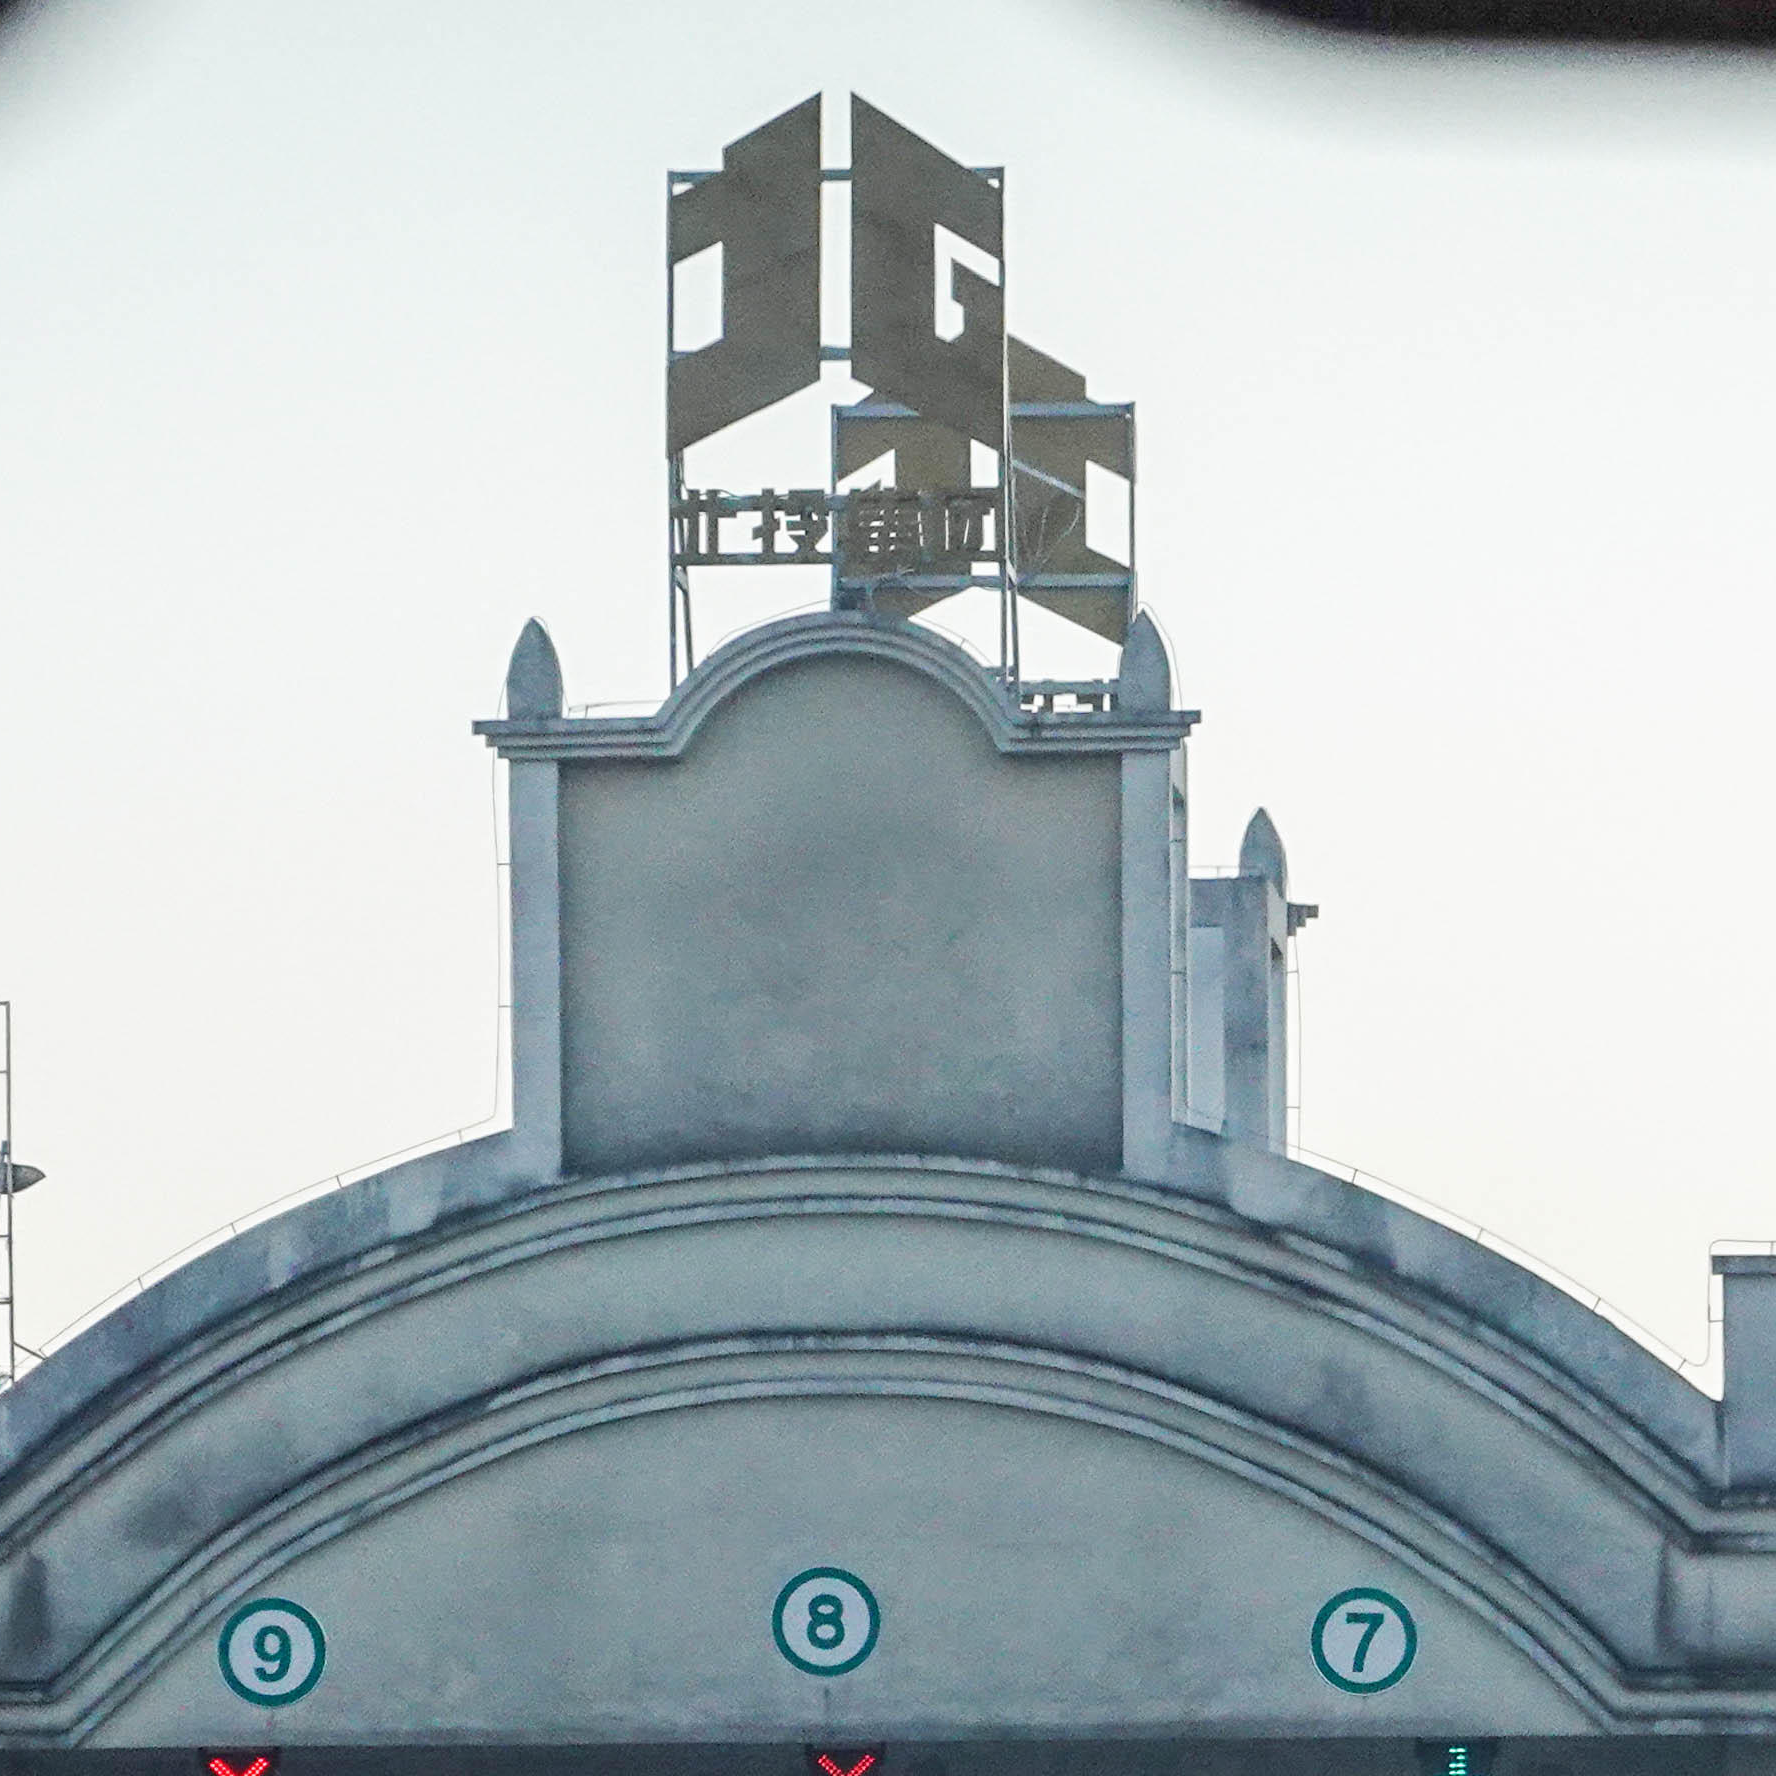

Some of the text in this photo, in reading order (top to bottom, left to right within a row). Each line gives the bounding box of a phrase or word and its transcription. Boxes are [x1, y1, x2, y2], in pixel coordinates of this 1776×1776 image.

[807, 1594, 845, 1650] 8
[1345, 1613, 1384, 1672] 7
[254, 1626, 291, 1682] 9
